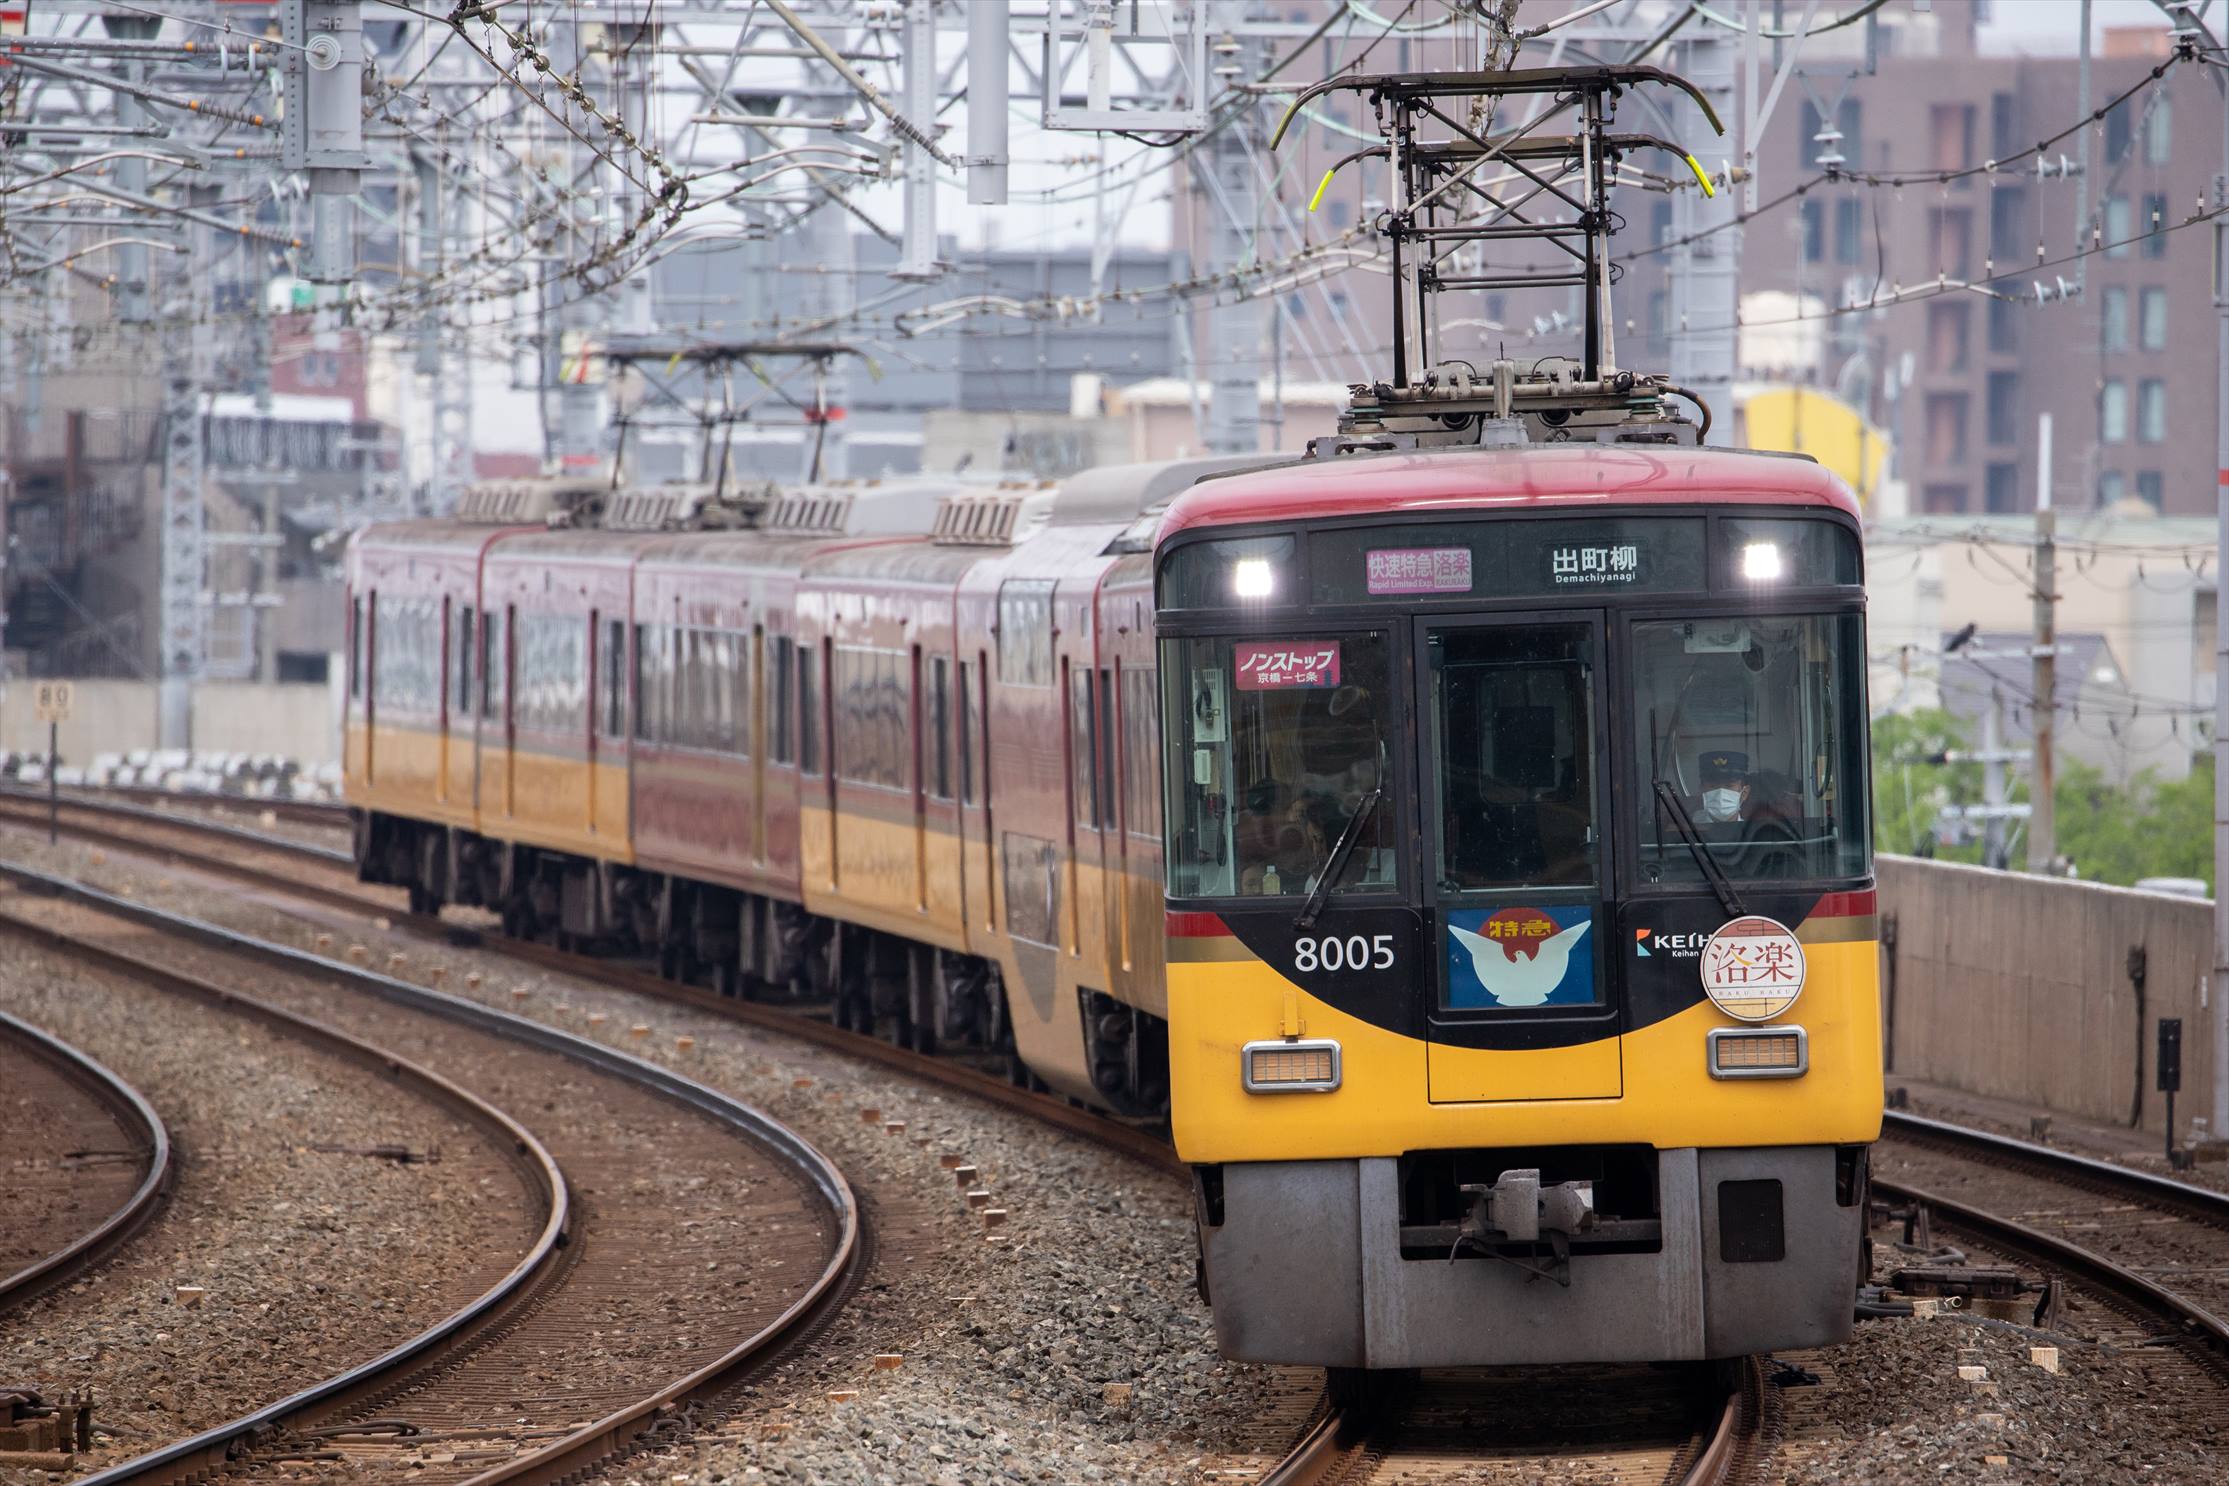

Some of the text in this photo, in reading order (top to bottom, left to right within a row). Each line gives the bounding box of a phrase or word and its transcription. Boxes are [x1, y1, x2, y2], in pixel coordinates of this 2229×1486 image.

[1368, 553, 1433, 578] 快速特急
[1437, 552, 1470, 576] 洛楽
[1553, 546, 1637, 573] 出町柳
[1368, 580, 1390, 590] Rapid
[1391, 579, 1418, 588] Limited
[1555, 571, 1636, 583] Demachiyanagi
[1241, 650, 1335, 671] ノンストップ
[1489, 920, 1551, 937] 特急
[1654, 932, 1713, 949] KEIH
[1295, 935, 1394, 972] 8005
[1711, 942, 1795, 983] 洛楽
